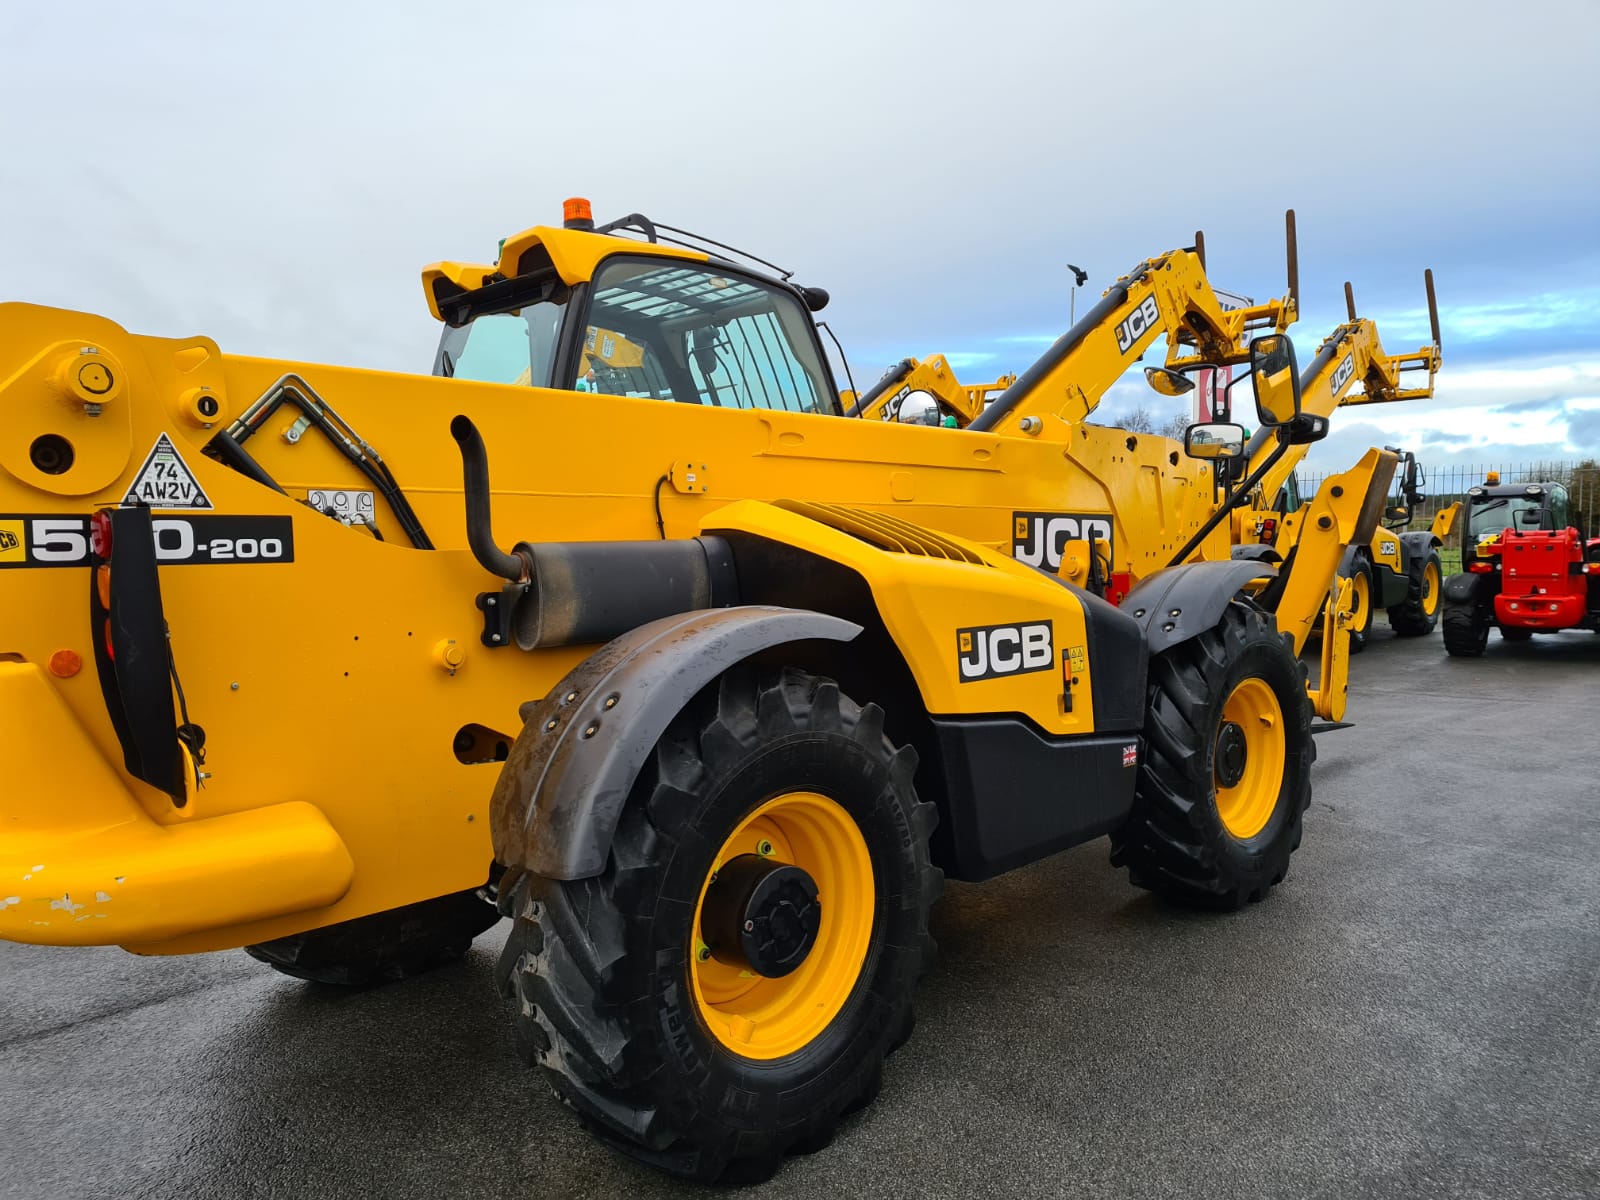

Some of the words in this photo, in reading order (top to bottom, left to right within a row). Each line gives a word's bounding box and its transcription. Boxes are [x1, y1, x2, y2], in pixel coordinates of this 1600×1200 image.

[1120, 296, 1158, 351] JCB
[1333, 354, 1354, 395] JCB
[143, 482, 191, 500] AW2V
[154, 462, 178, 480] 74
[0, 532, 17, 548] CB
[31, 519, 283, 561] 50-200
[961, 625, 1052, 677] JCB
